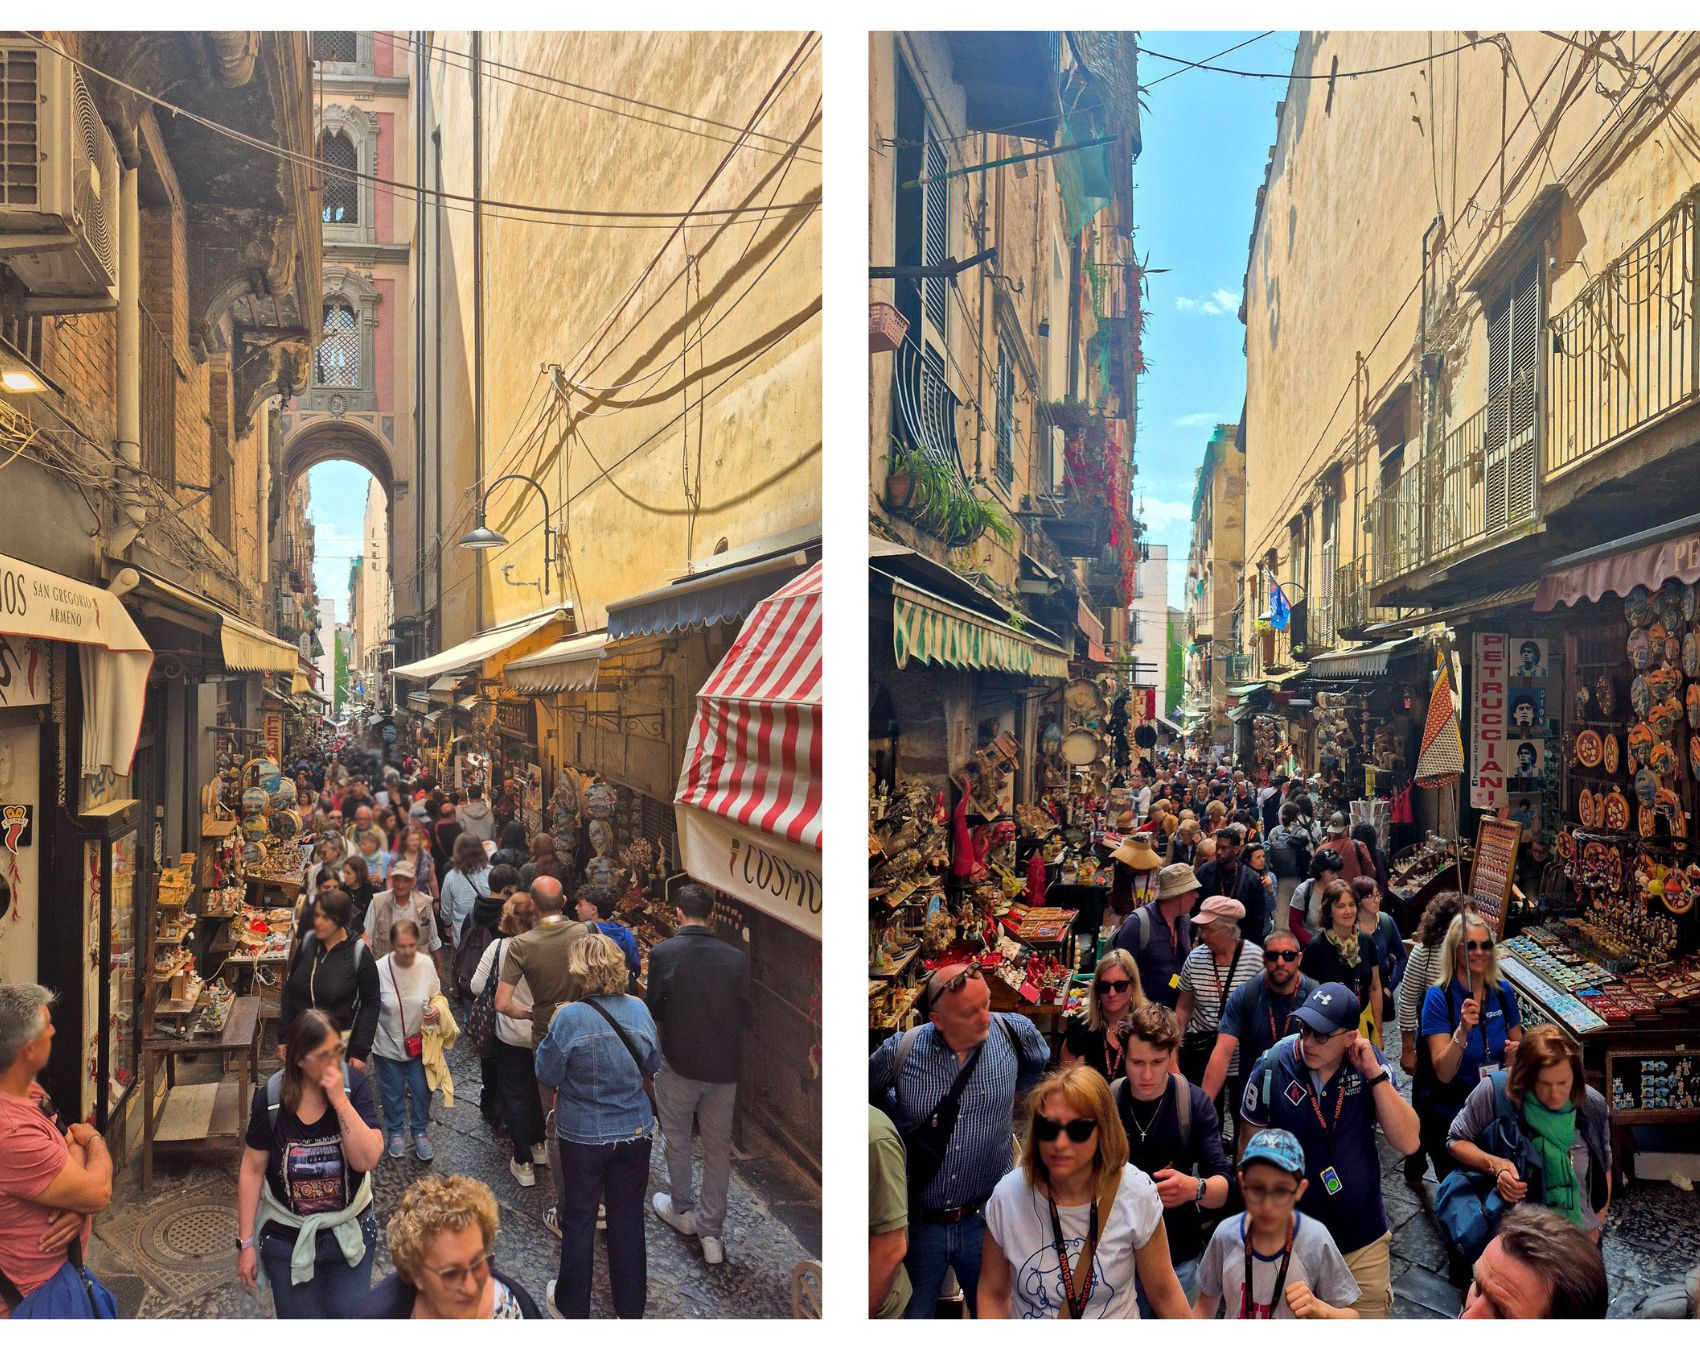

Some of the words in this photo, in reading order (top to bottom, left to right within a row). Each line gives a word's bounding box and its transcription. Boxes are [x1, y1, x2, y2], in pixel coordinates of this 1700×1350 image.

[0, 568, 27, 617] OS
[33, 580, 51, 600] SAN
[52, 586, 93, 610] GREGORIO
[49, 607, 82, 627] ARMENO
[1480, 635, 1503, 805] PETRUCCIANI
[744, 845, 822, 914] COSMO
[1059, 1253, 1075, 1300] MUSOUND
